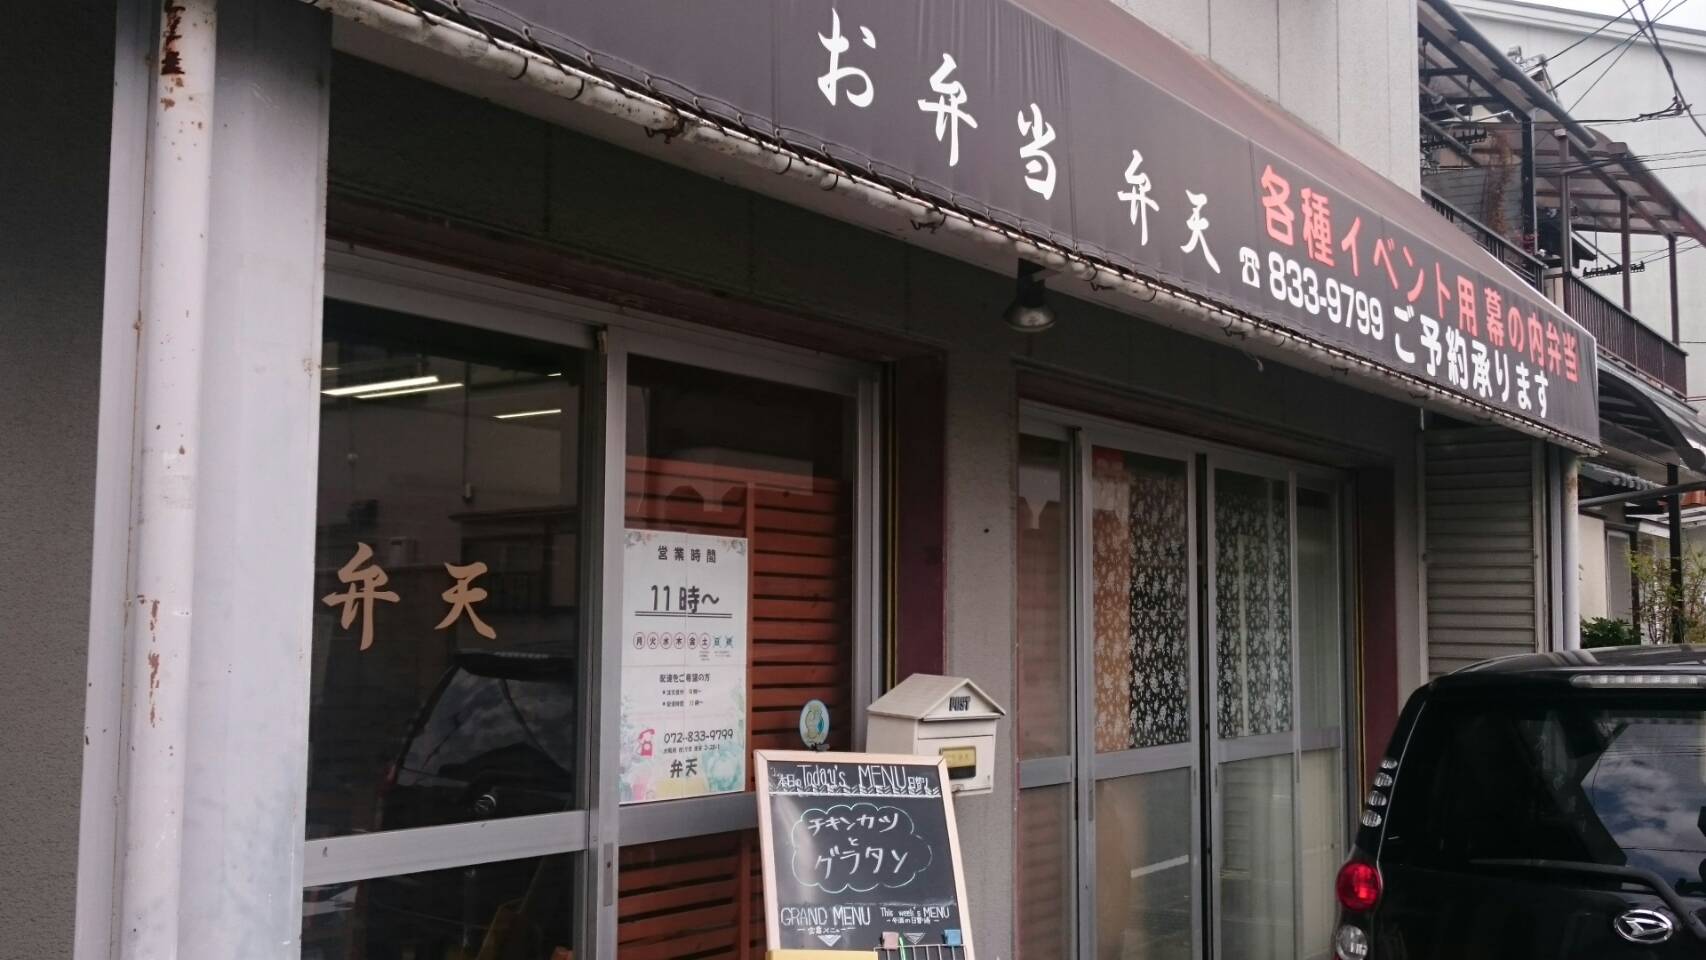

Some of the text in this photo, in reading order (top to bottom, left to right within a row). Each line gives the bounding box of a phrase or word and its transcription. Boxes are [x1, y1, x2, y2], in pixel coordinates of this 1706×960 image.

[817, 8, 1221, 274] お弁当 弁天
[1268, 252, 1550, 419] 833-9799 ご予約承ります
[657, 545, 717, 563] 営業時間
[321, 541, 497, 651] 弁天
[949, 695, 971, 711] POST
[663, 728, 734, 744] 072-833-9799
[669, 758, 698, 778] 弁天
[797, 765, 847, 788] Today's
[858, 765, 907, 789] MENU
[807, 813, 899, 836] チキンカツ
[848, 837, 860, 847] と
[814, 846, 909, 880] グラタン
[781, 905, 871, 926] GRAND MENU
[880, 907, 894, 918] This
[923, 906, 950, 919] MENU
